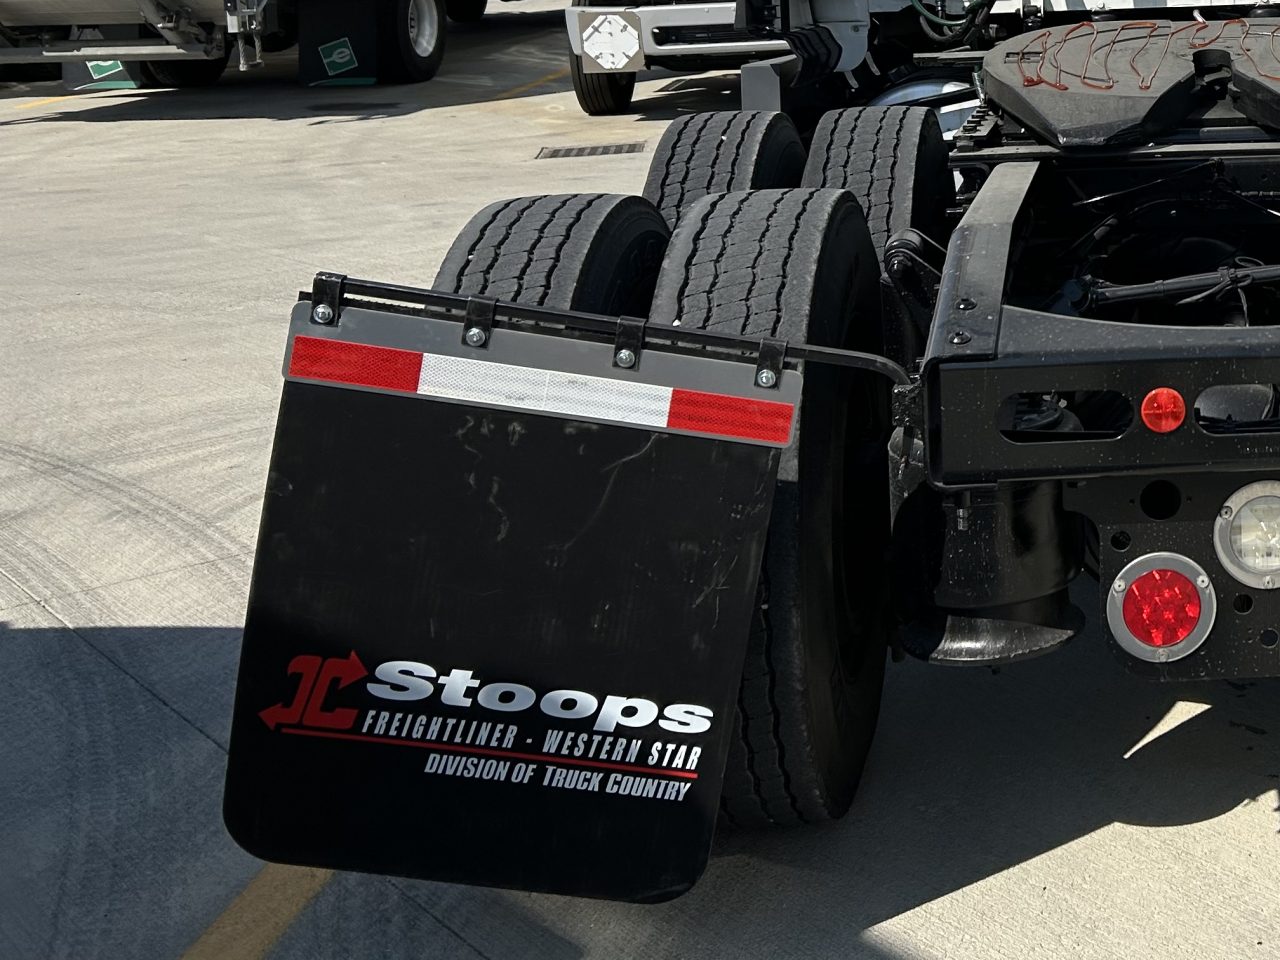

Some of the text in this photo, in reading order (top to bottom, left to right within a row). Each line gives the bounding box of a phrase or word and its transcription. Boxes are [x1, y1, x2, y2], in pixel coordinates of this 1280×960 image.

[366, 660, 714, 734] Stoops
[361, 709, 518, 749] FREIGHTLINER
[542, 729, 642, 763] WESTERN
[647, 741, 702, 770] STAR
[424, 753, 692, 802] DIVISION OF TRUCK COUNTRY
